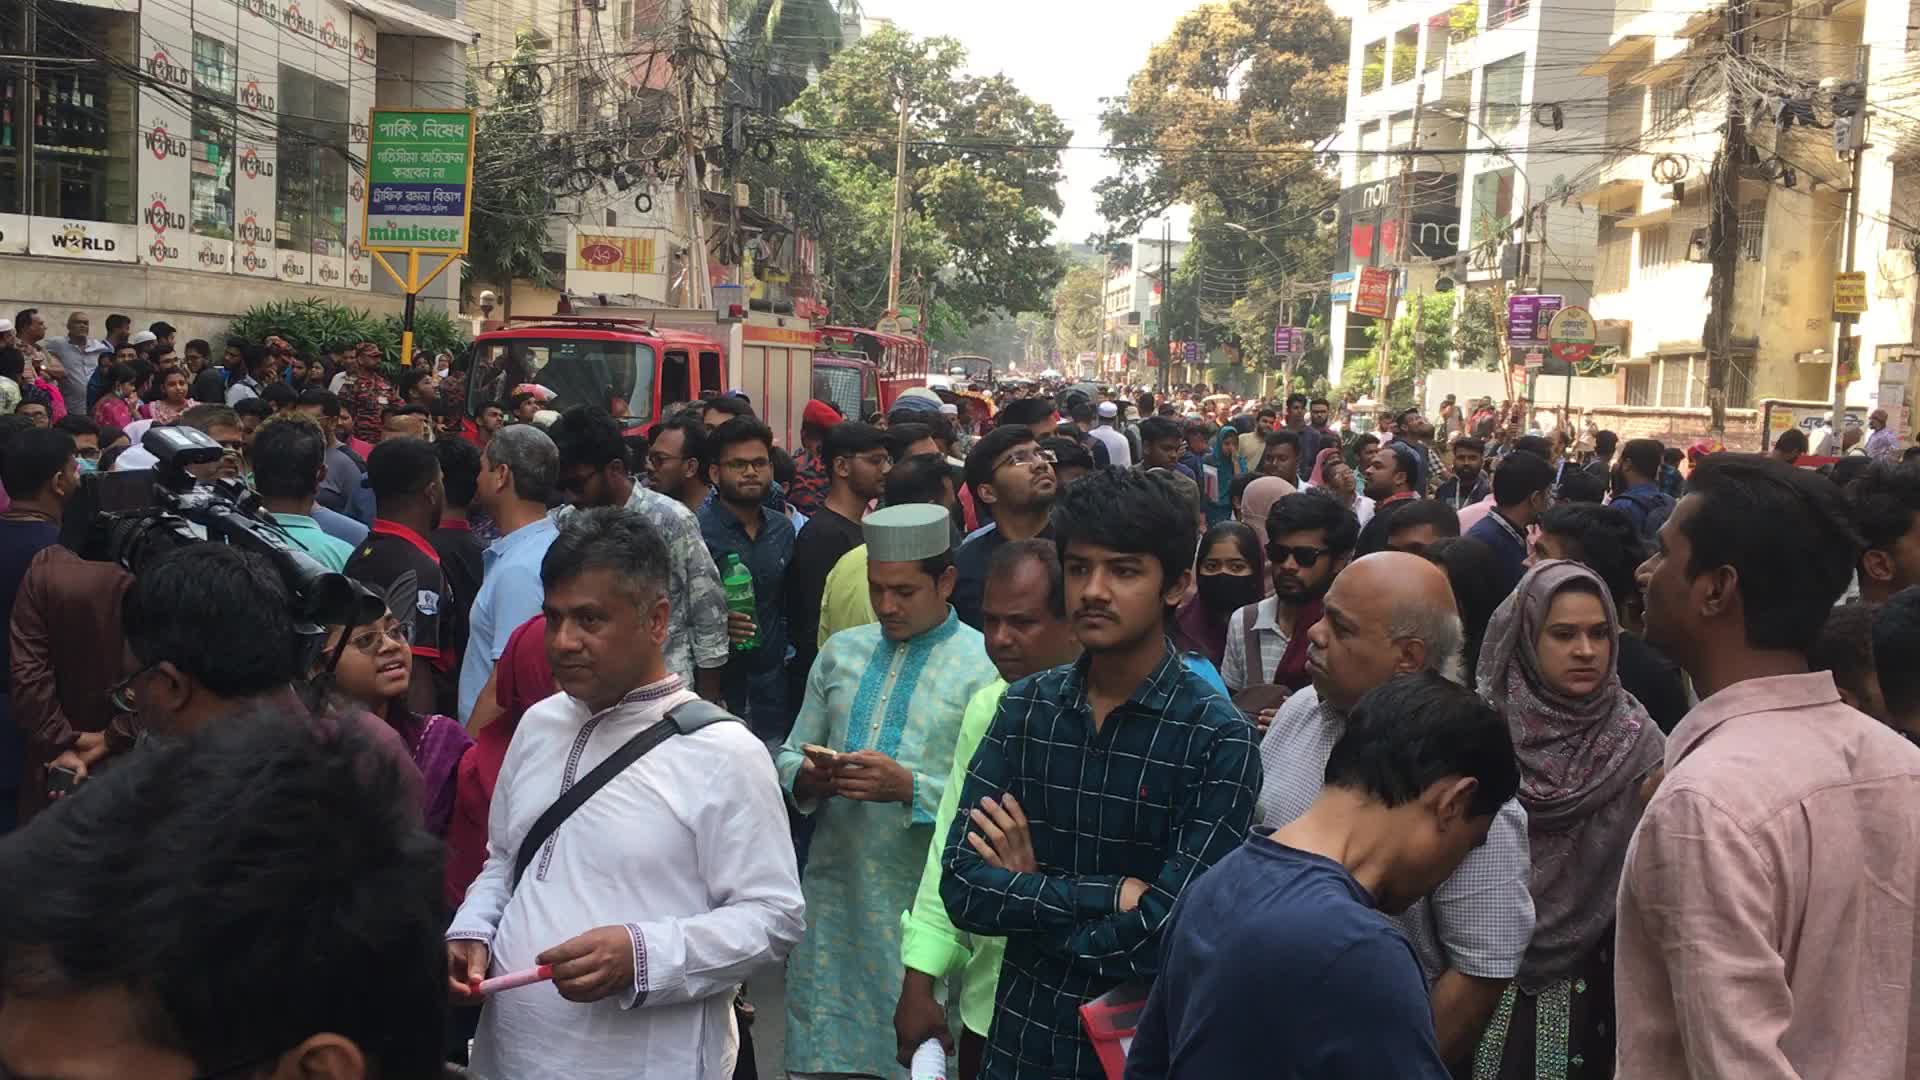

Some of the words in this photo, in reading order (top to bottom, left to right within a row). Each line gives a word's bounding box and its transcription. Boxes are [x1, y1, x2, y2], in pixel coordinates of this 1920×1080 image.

[422, 118, 465, 138] নিষেধ
[144, 130, 187, 159] WORLD
[1362, 179, 1392, 209] noir
[144, 205, 186, 231] WORLD
[51, 233, 116, 252] WORLD
[369, 220, 459, 243] minister
